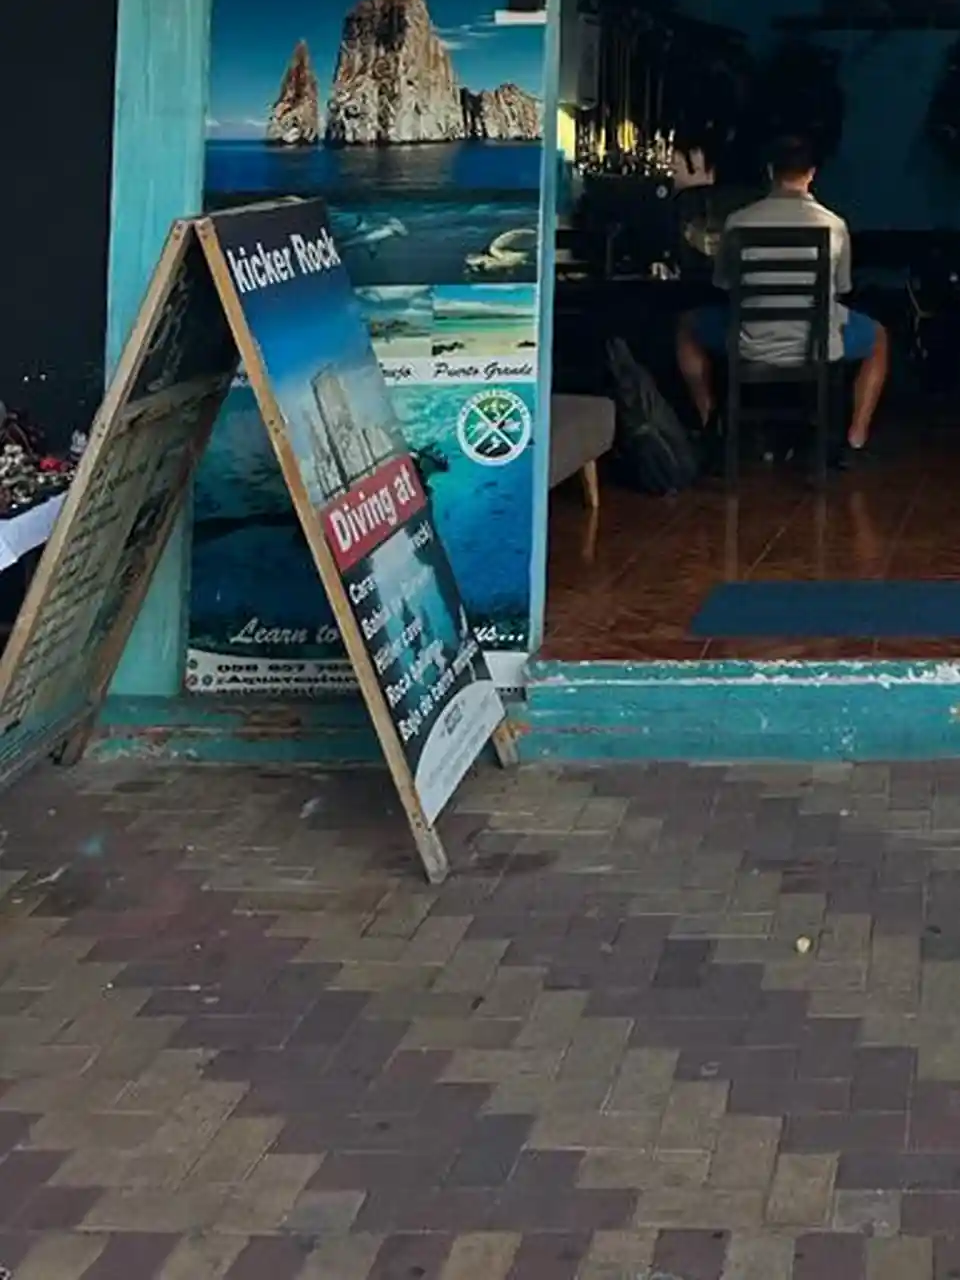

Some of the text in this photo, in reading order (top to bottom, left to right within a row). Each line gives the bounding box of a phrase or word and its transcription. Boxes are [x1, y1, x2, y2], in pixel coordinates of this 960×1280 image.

[290, 226, 341, 275] Rock
[483, 361, 533, 380] Grande
[329, 463, 416, 552] Diving at
[229, 616, 308, 645] Learn
[315, 624, 339, 644] to
